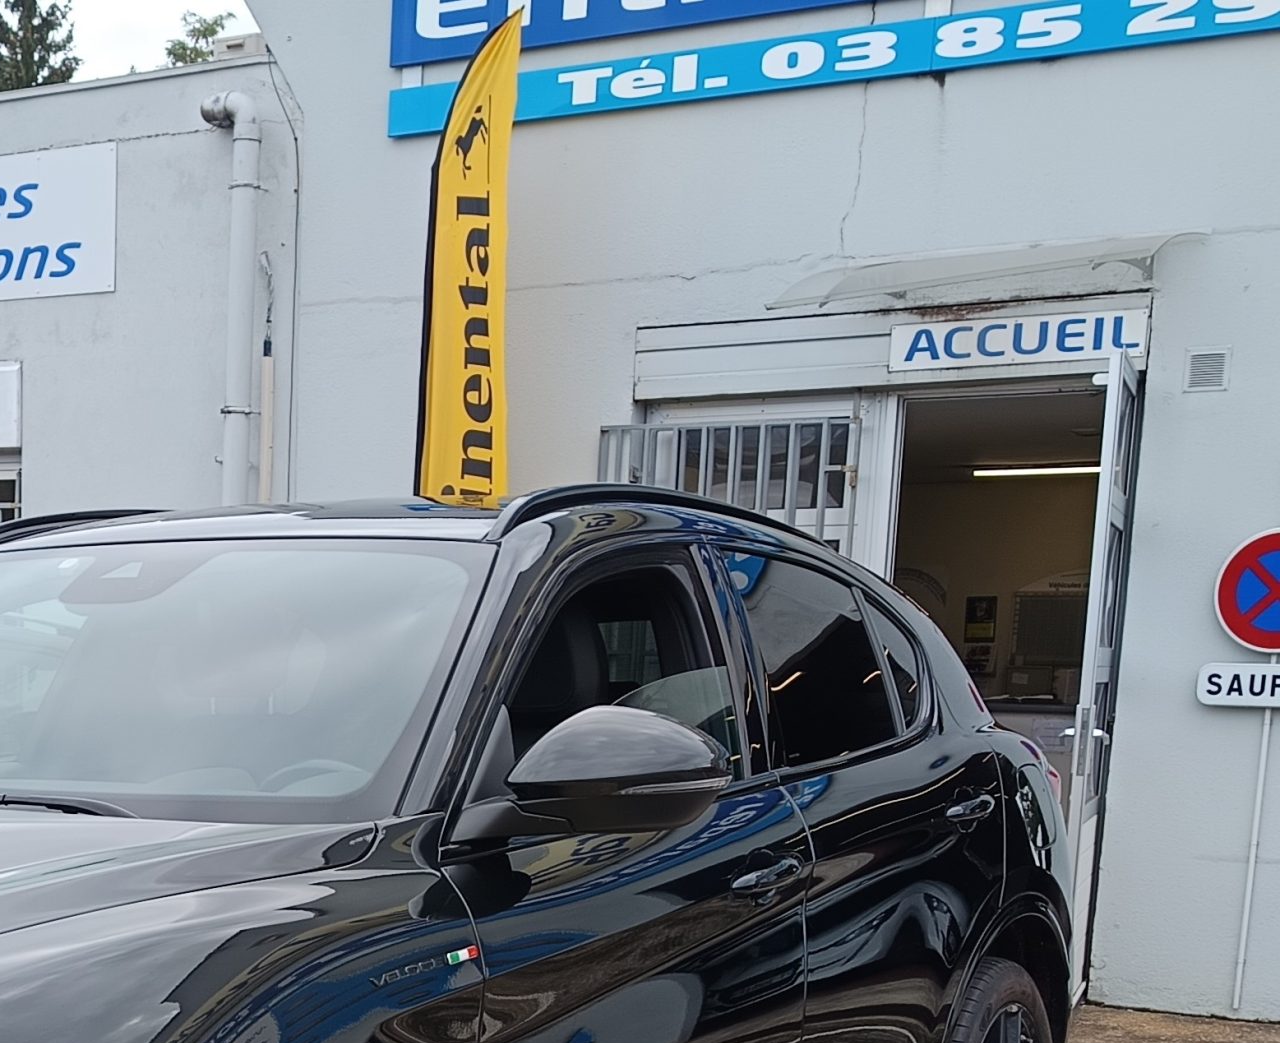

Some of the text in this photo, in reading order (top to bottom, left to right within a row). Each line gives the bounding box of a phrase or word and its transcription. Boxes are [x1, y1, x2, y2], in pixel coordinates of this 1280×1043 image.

[557, 53, 729, 106] Tél.
[761, 30, 898, 80] 03
[934, 3, 1083, 58] 85
[903, 316, 1140, 363] ACCUEIL
